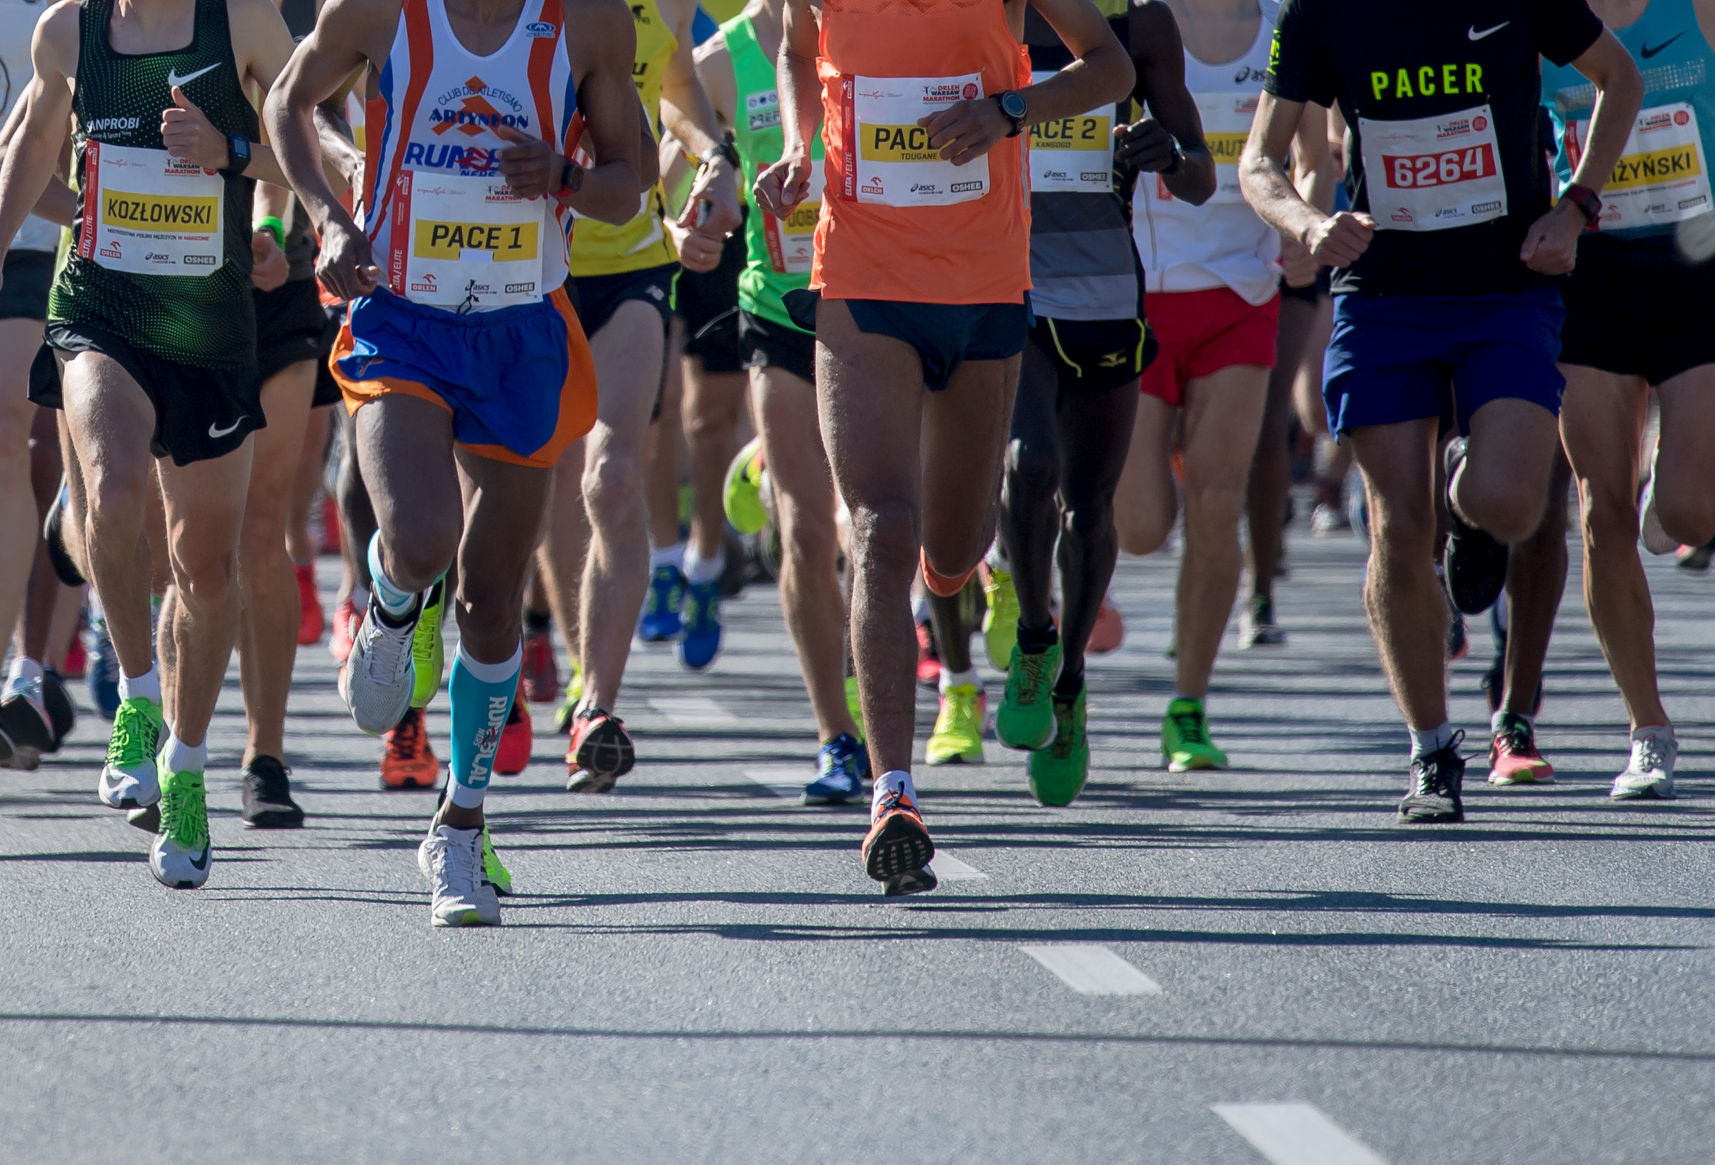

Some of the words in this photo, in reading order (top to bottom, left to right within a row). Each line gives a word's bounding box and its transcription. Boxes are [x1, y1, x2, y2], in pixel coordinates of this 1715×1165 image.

[1370, 63, 1484, 100] PACER
[438, 87, 461, 106] CLUB
[462, 86, 474, 95] DE
[476, 86, 523, 112] ATLETISMO
[86, 116, 140, 133] SANPROBI
[1029, 118, 1075, 140] ACE
[1081, 118, 1097, 140] 2
[901, 153, 938, 161] TOUGANE
[1394, 148, 1484, 187] 6264
[862, 186, 883, 194] ORLEN
[952, 182, 981, 192] OSHEE
[108, 198, 211, 225] KOZŁOWSKI
[431, 225, 502, 249] PACE
[507, 227, 522, 249] 1
[100, 249, 121, 258] ORLEN
[185, 256, 215, 264] OSHEE
[412, 284, 436, 292] ORLEN
[506, 284, 534, 292] OSHEE
